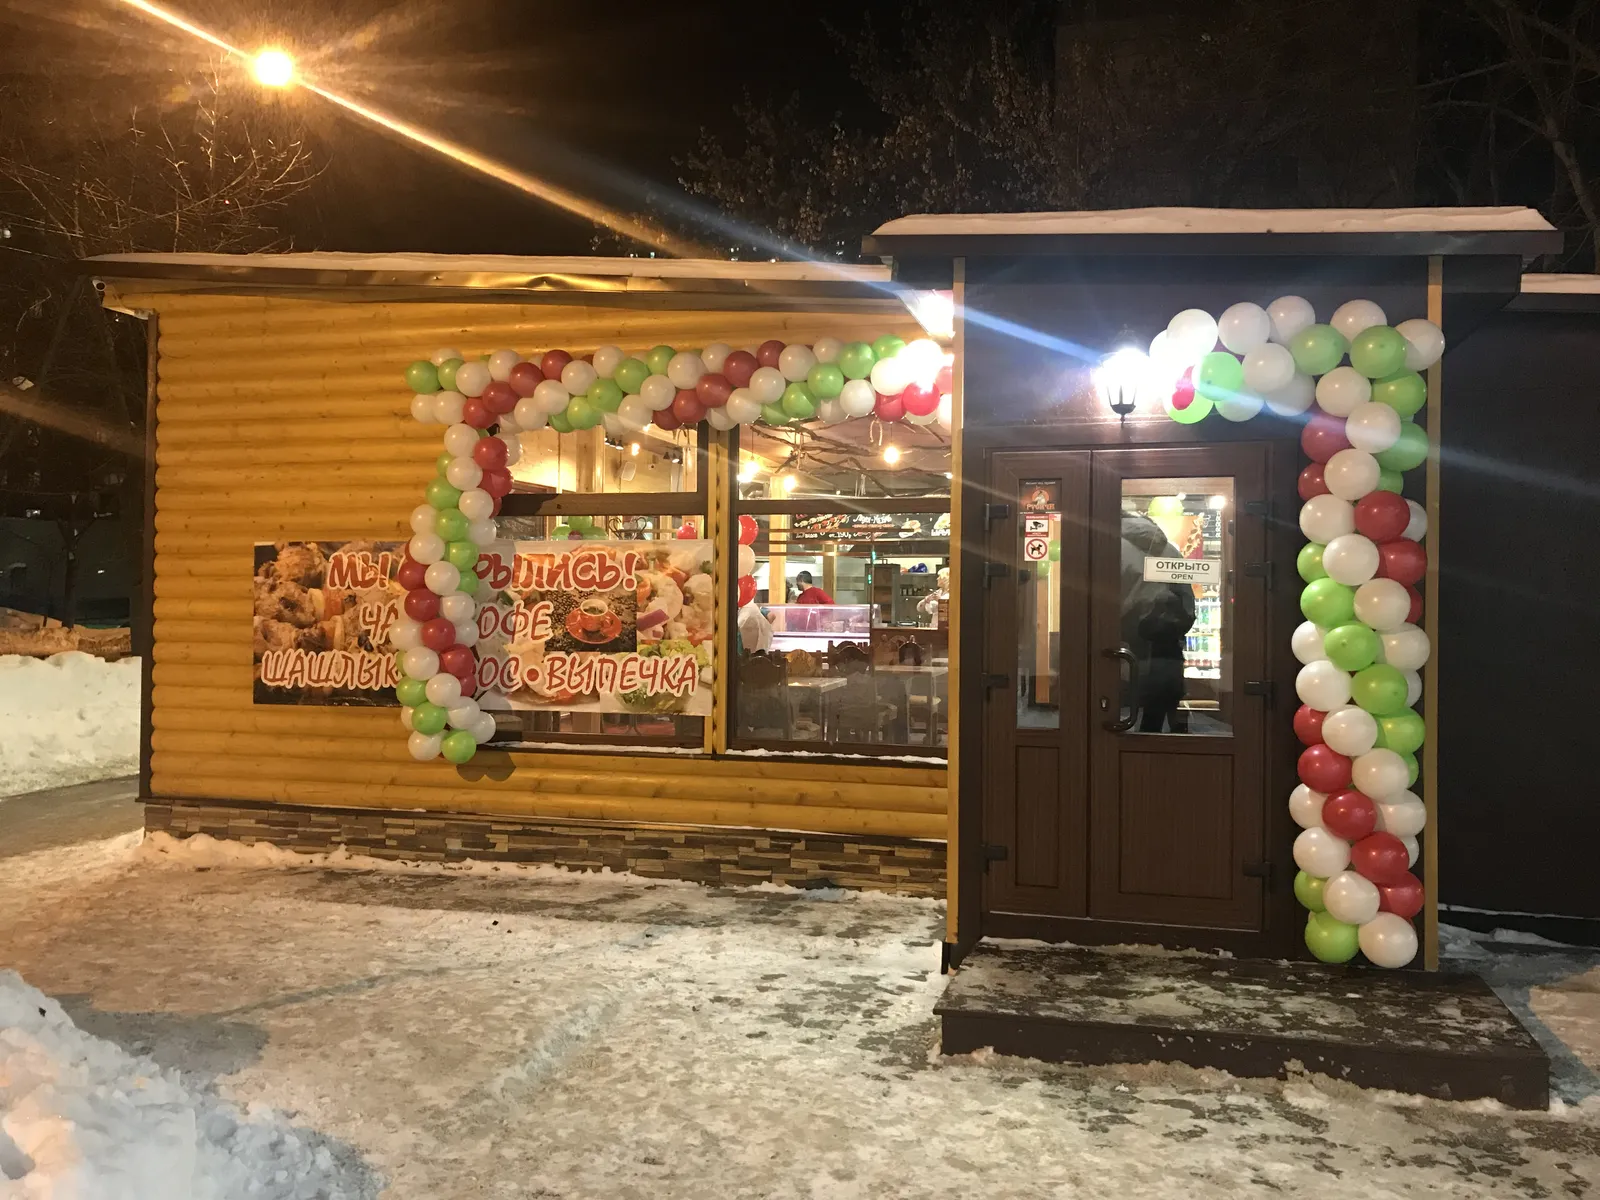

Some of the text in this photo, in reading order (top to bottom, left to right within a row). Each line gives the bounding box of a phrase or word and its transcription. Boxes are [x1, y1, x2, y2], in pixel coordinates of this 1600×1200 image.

[329, 552, 639, 591] МЫ РЫЛИСЬ!
[1155, 560, 1210, 572] ОТКРЫТО
[361, 602, 553, 643] ЧА ОФЕ
[262, 652, 402, 690] ШАШЛЫК
[545, 655, 698, 694] ВЫПЕЧКА
